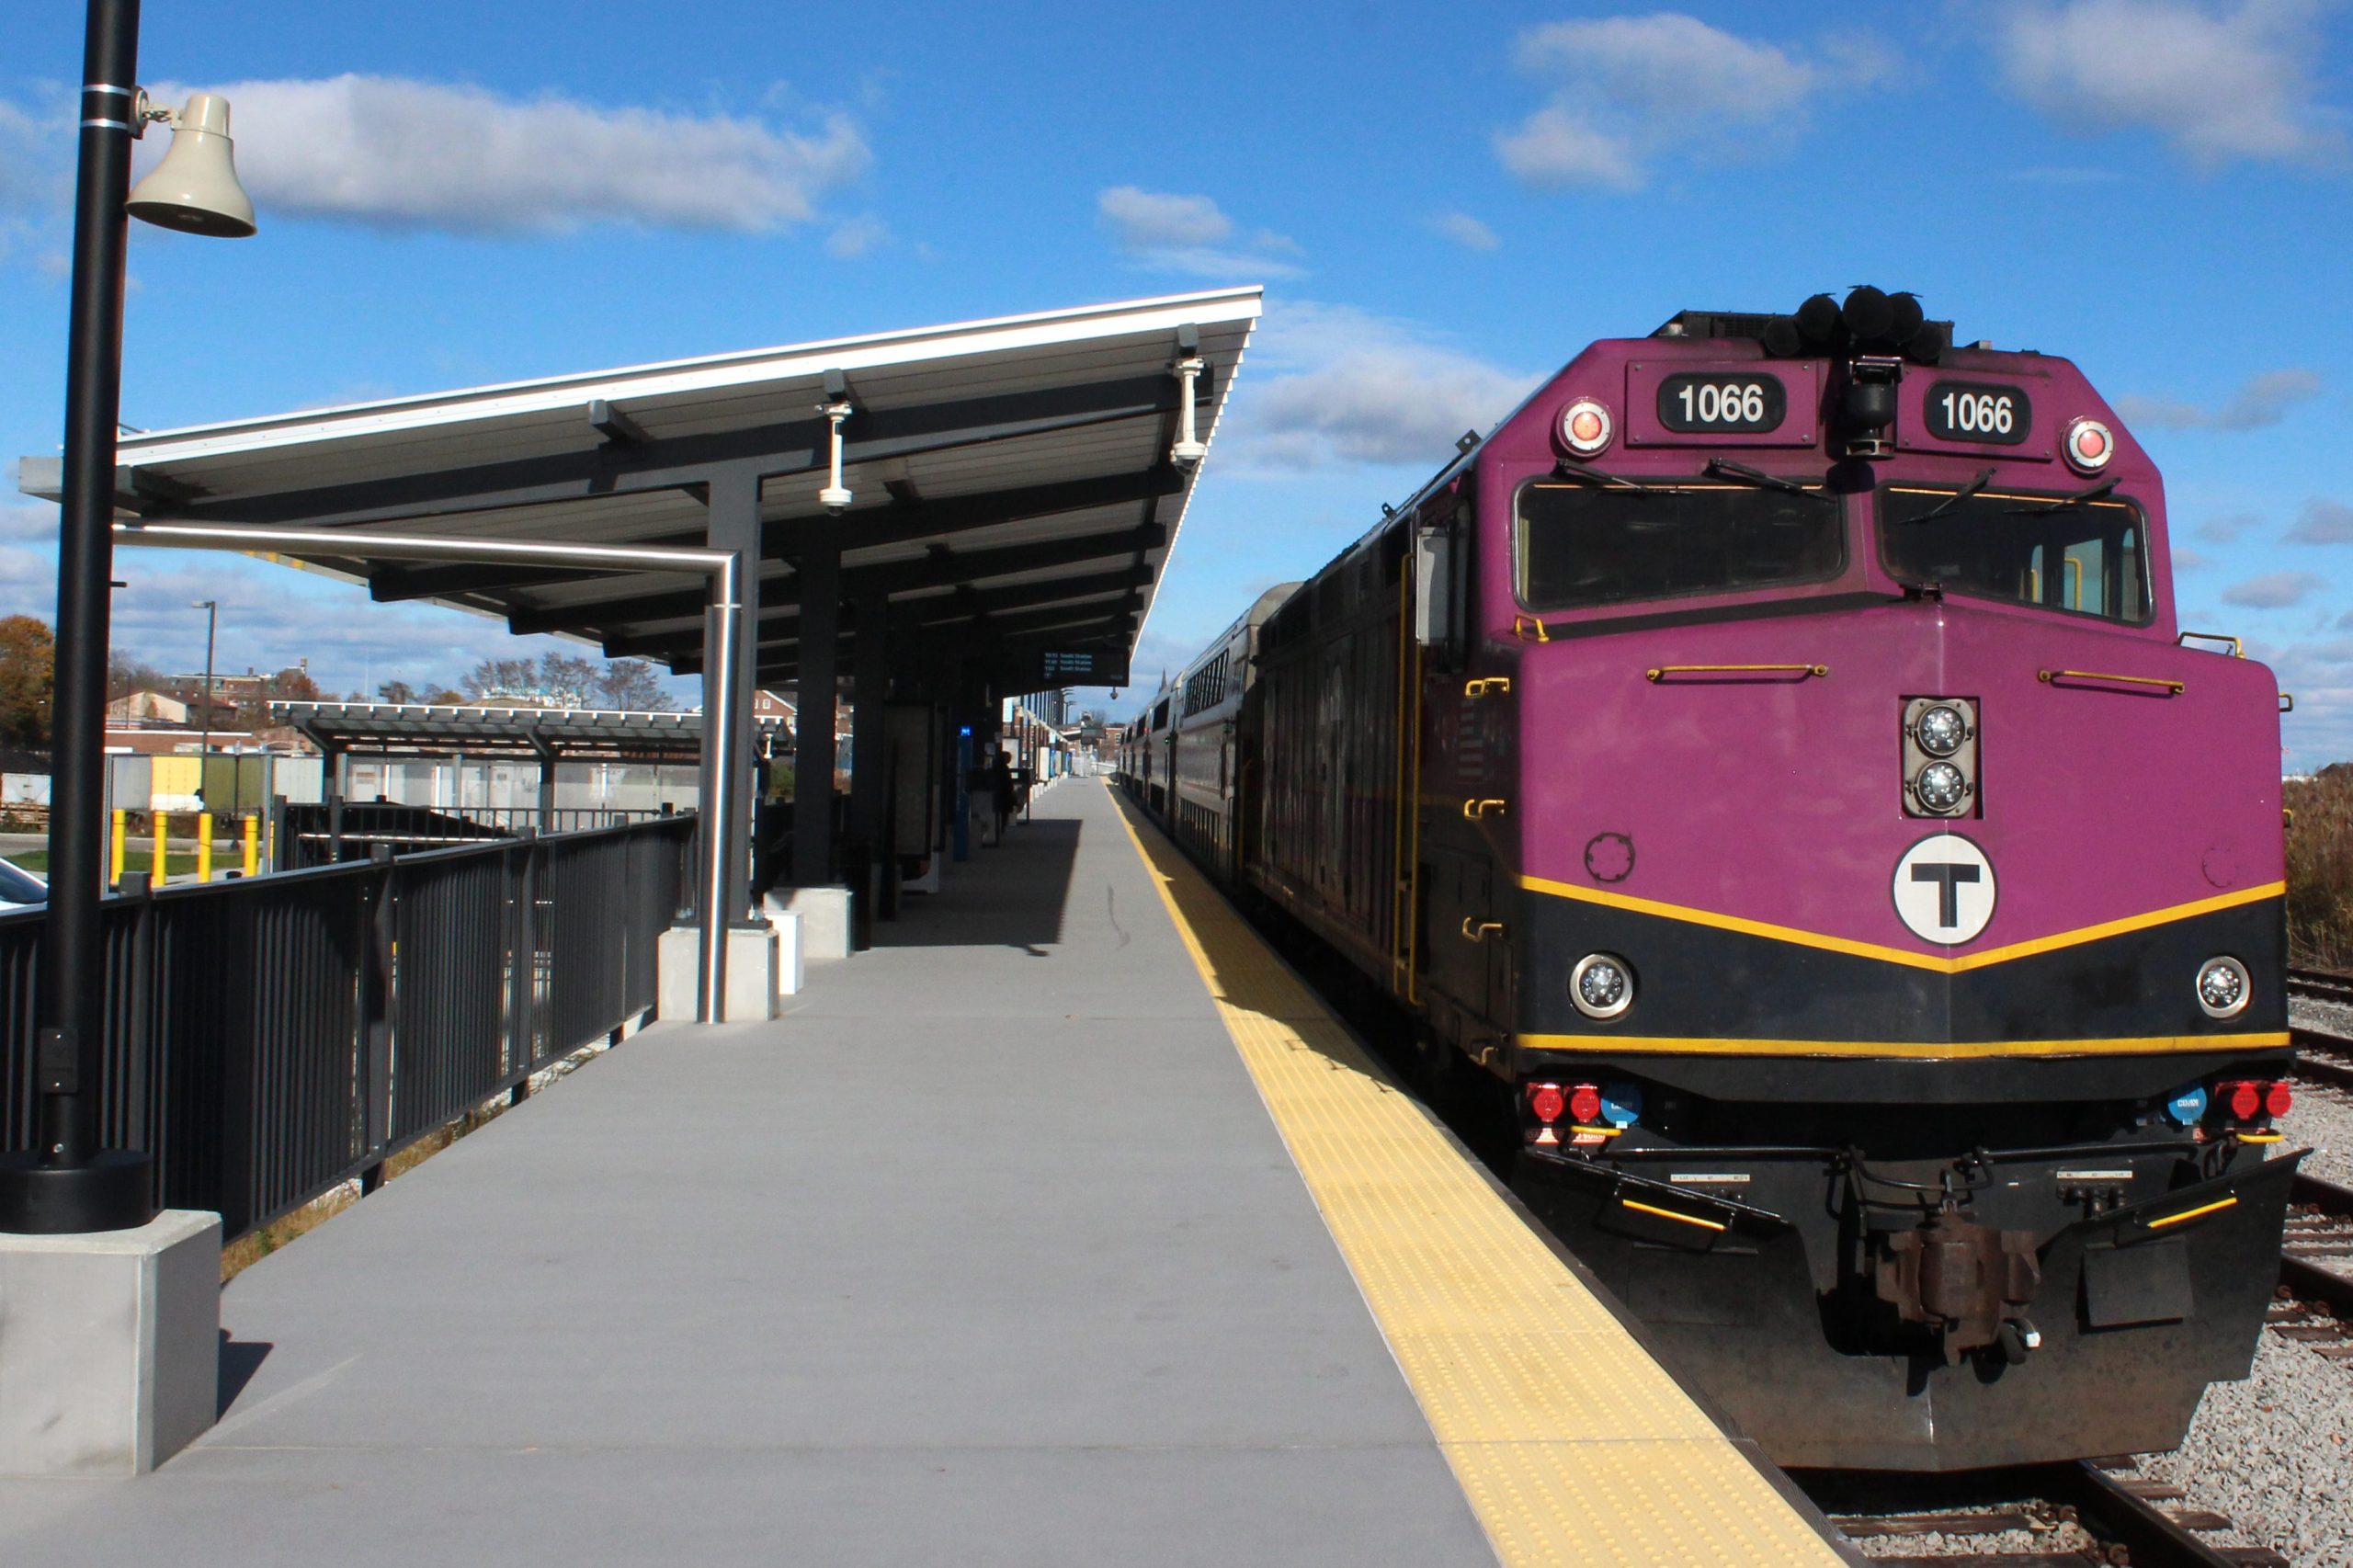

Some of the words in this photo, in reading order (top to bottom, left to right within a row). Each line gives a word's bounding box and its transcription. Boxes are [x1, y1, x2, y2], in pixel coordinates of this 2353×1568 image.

[1678, 383, 1764, 423] 1066
[1941, 392, 2013, 435] 1066
[1910, 862, 1981, 928] T
